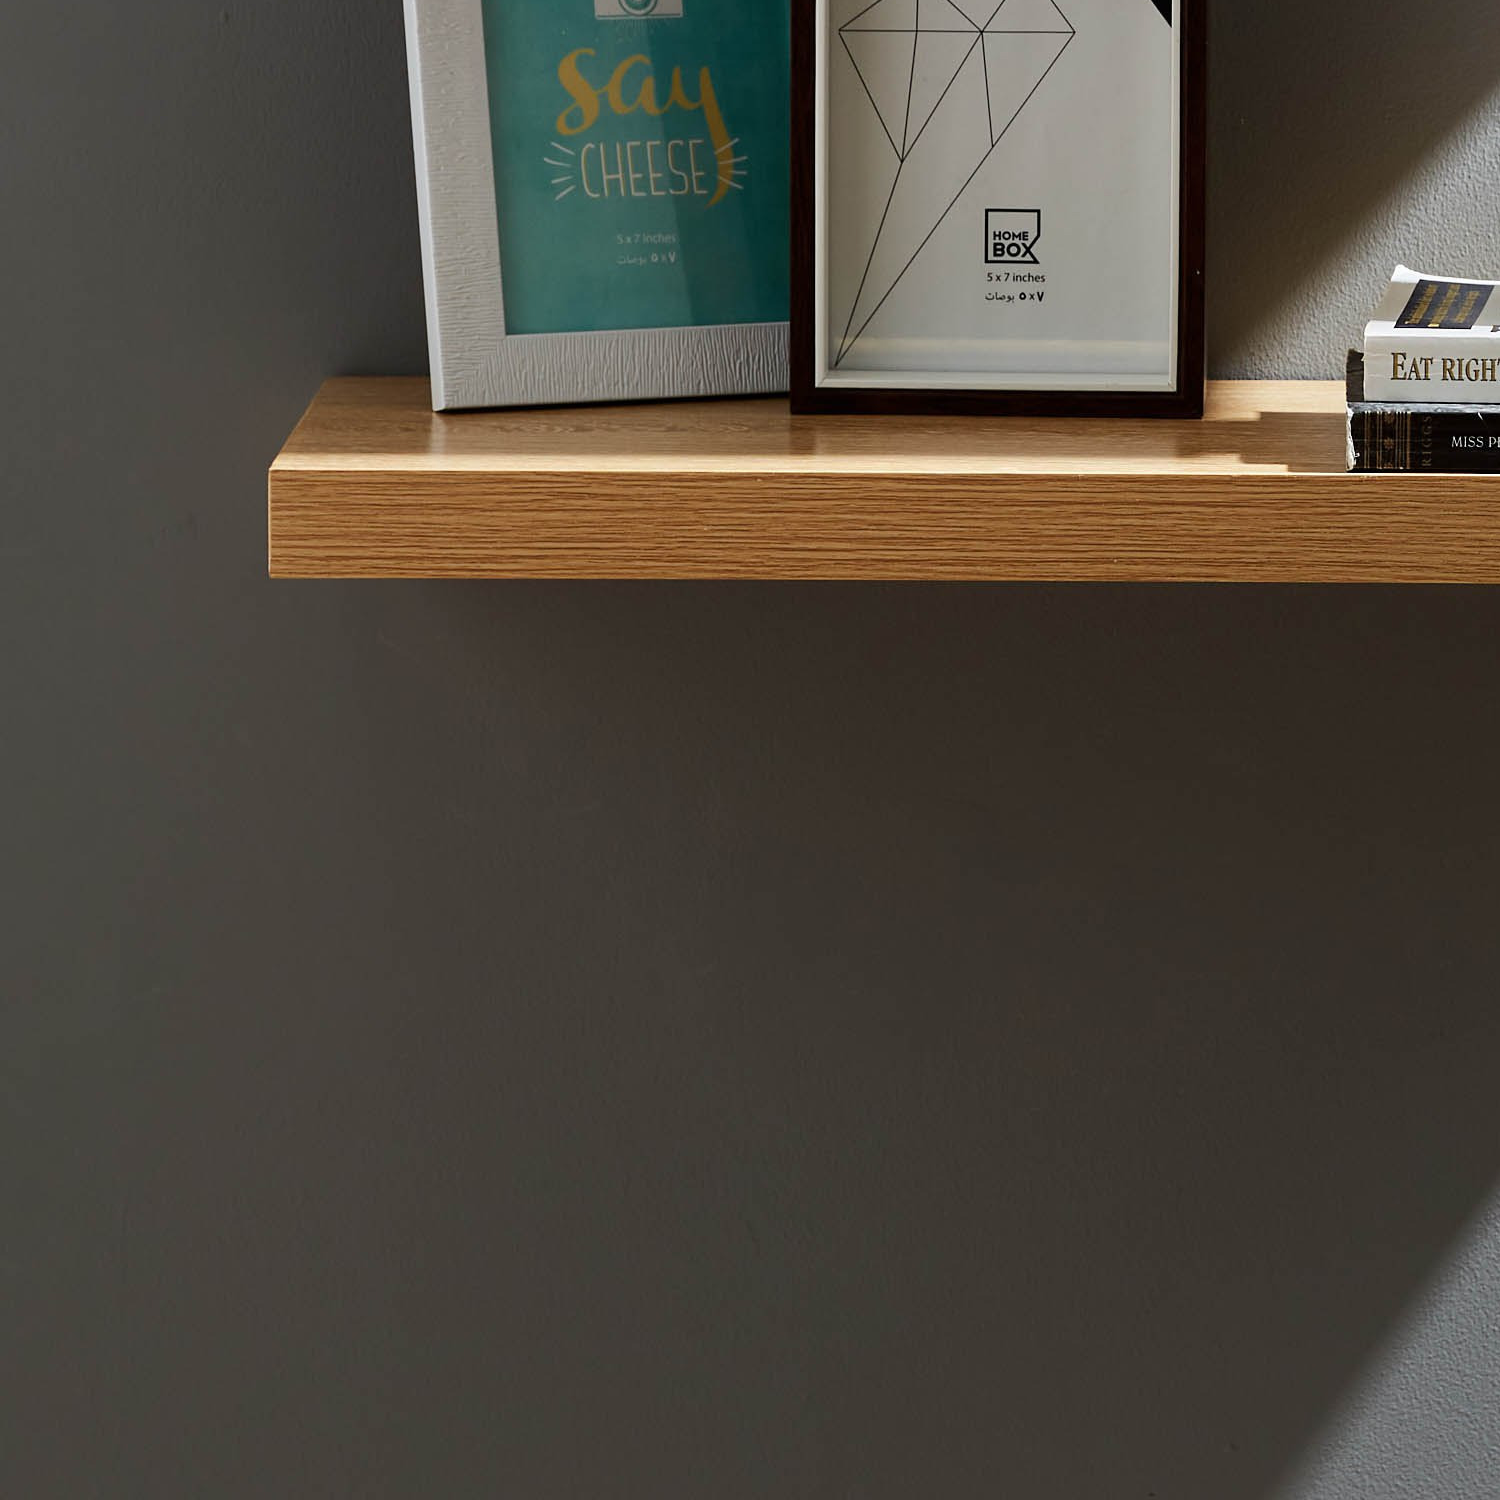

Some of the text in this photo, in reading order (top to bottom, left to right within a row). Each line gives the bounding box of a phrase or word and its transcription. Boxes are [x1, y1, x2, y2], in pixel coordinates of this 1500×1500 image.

[581, 138, 709, 198] CHEESE
[992, 231, 1029, 241] HOME
[992, 242, 1035, 258] BOX
[986, 272, 1046, 283] 5 x 7 inches
[1421, 415, 1433, 468] RIGGS
[1451, 436, 1484, 449] MISS
